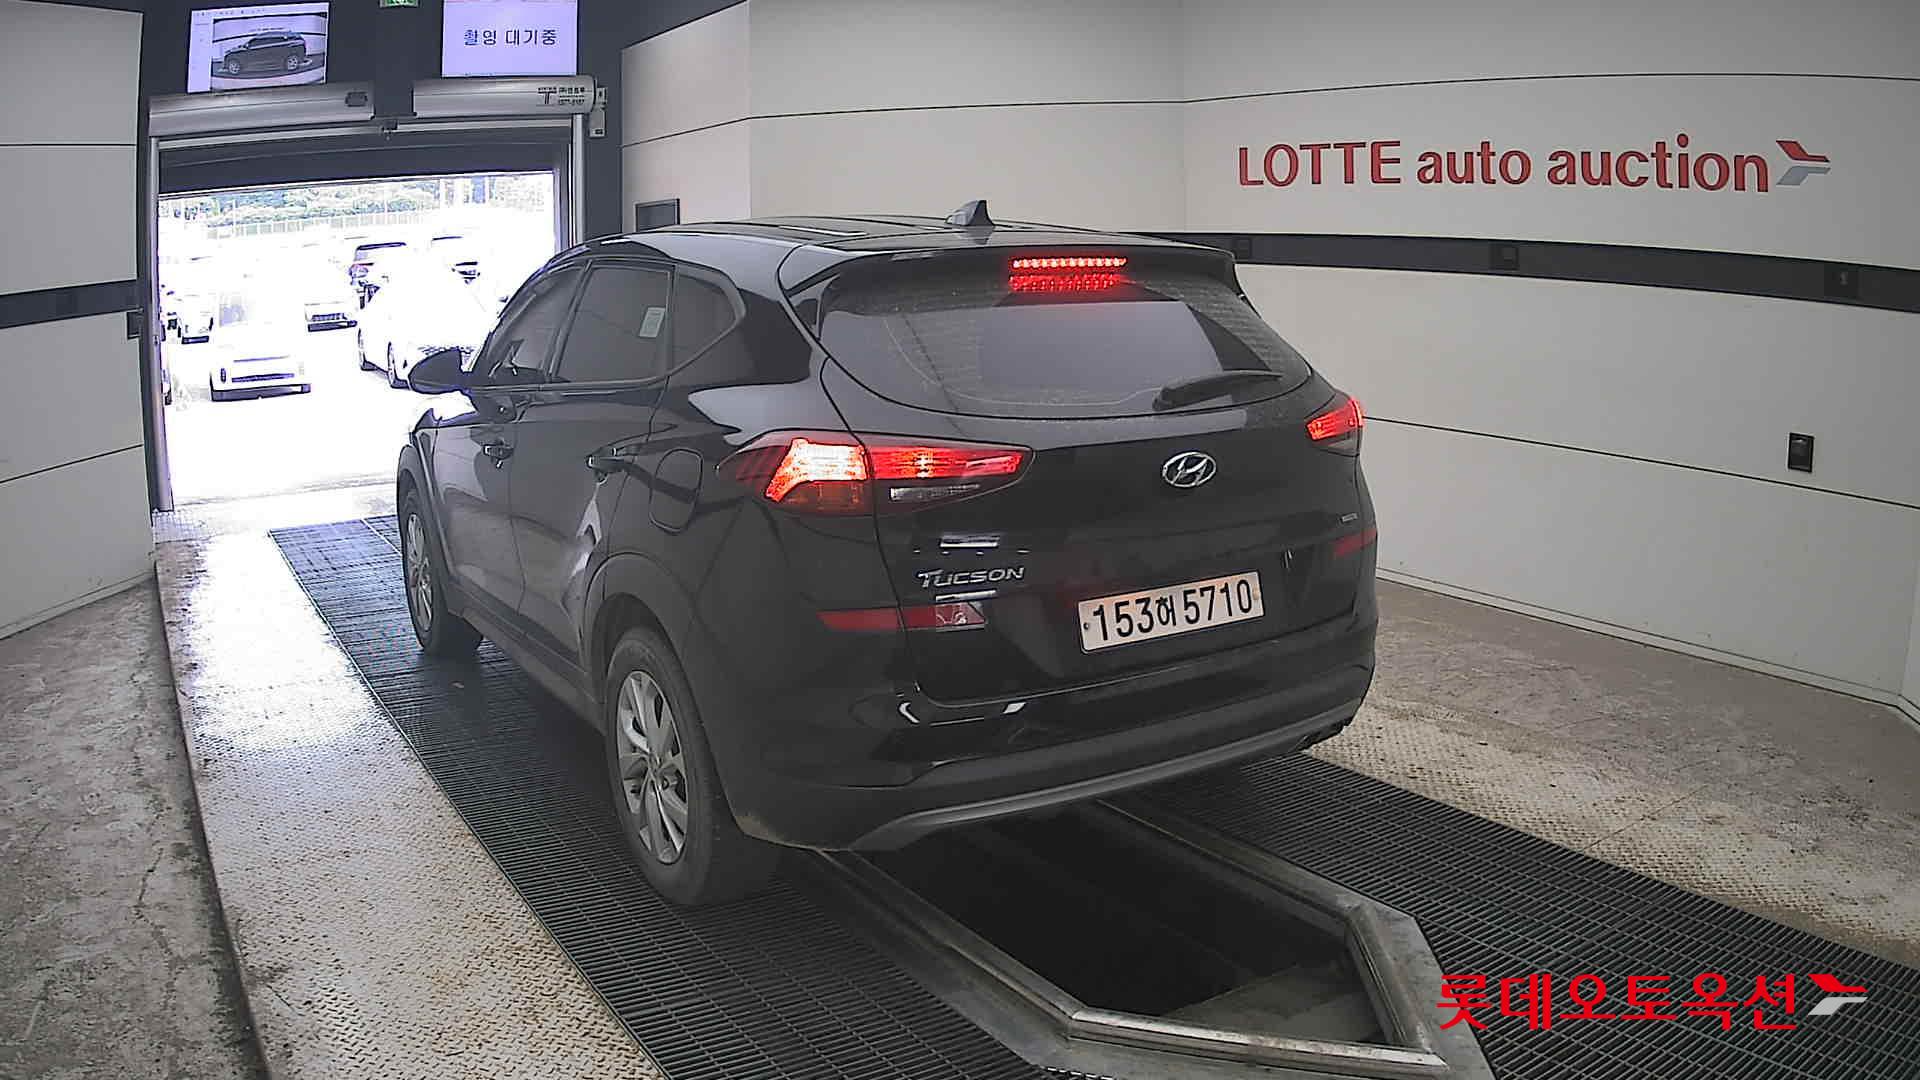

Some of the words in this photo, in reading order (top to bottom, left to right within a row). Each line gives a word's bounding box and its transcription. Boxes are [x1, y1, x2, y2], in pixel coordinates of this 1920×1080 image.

[505, 29, 557, 46] 대기중
[1239, 140, 1401, 187] LOTTE
[1417, 141, 1531, 184] auto
[1547, 133, 1769, 193] auction
